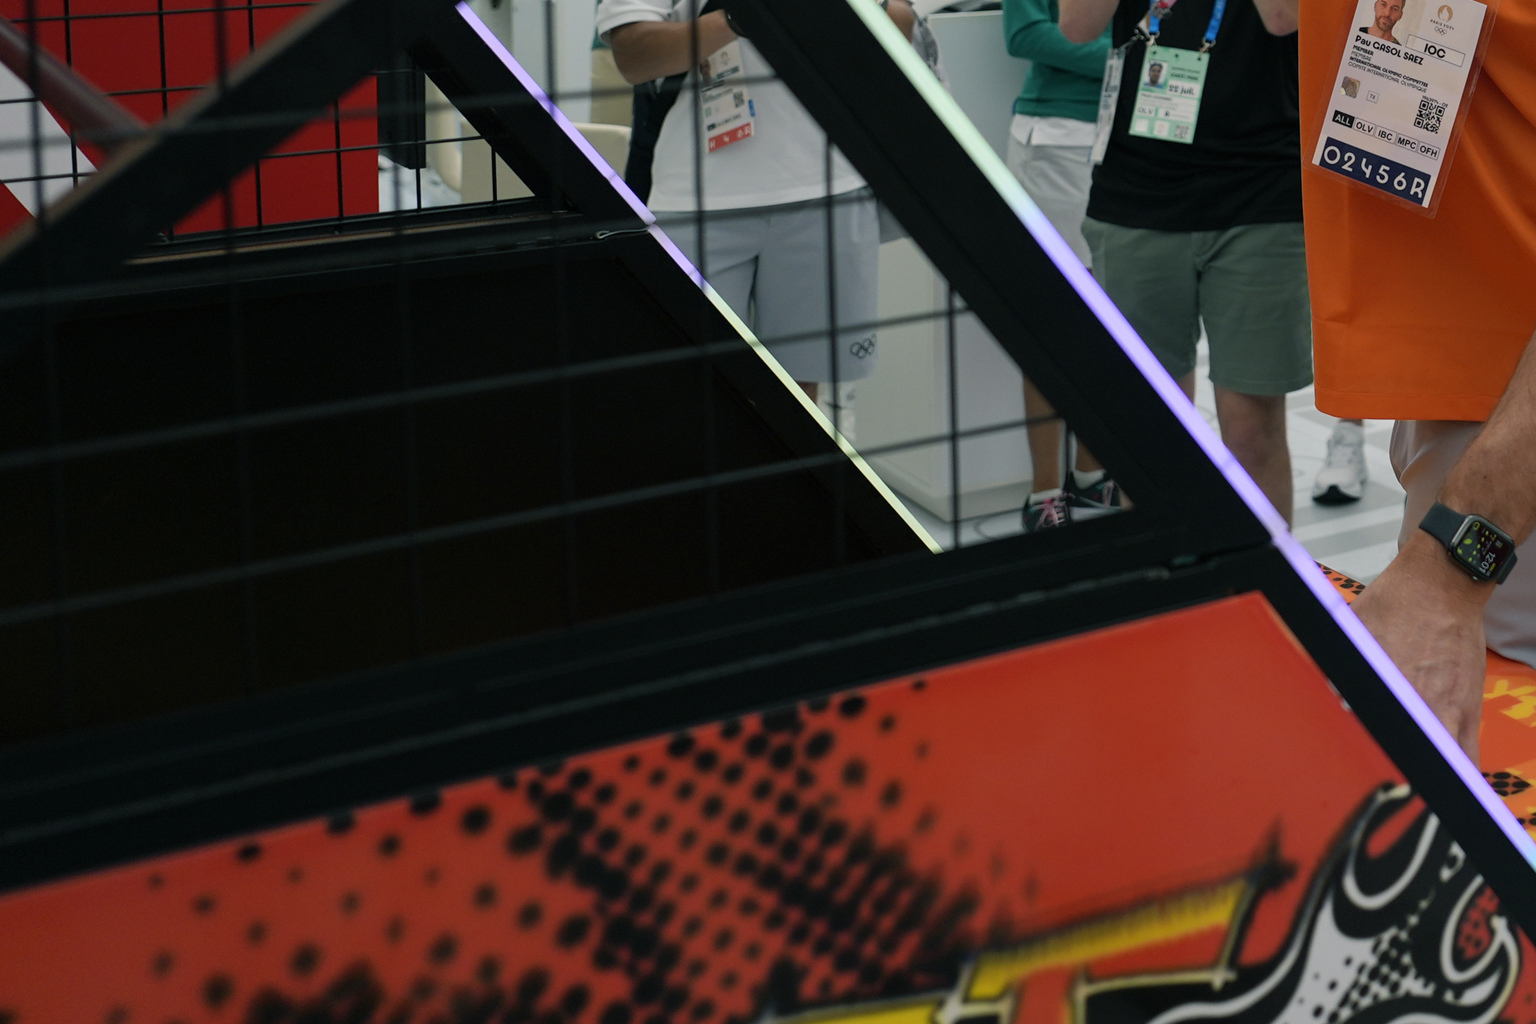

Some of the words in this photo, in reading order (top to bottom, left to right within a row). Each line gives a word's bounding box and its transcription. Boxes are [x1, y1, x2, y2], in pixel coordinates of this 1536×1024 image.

[1352, 45, 1374, 56] MEMBER
[1355, 35, 1371, 47] Pau
[1372, 41, 1402, 58] GASOL
[1403, 52, 1424, 66] SAEZ
[1424, 43, 1446, 59] IOC
[1349, 56, 1381, 72] INTERNATIONAL
[1382, 67, 1402, 79] OLYMPIC
[1402, 74, 1428, 88] COMMITTEE
[1366, 67, 1400, 84] INTERNATIONAL
[1400, 80, 1427, 93] OLYMPIQUE
[1334, 114, 1351, 126] ALL
[1355, 121, 1374, 133] OLV
[1378, 129, 1393, 141] IBC
[1397, 137, 1417, 150] MPC
[1419, 145, 1438, 158] OFH
